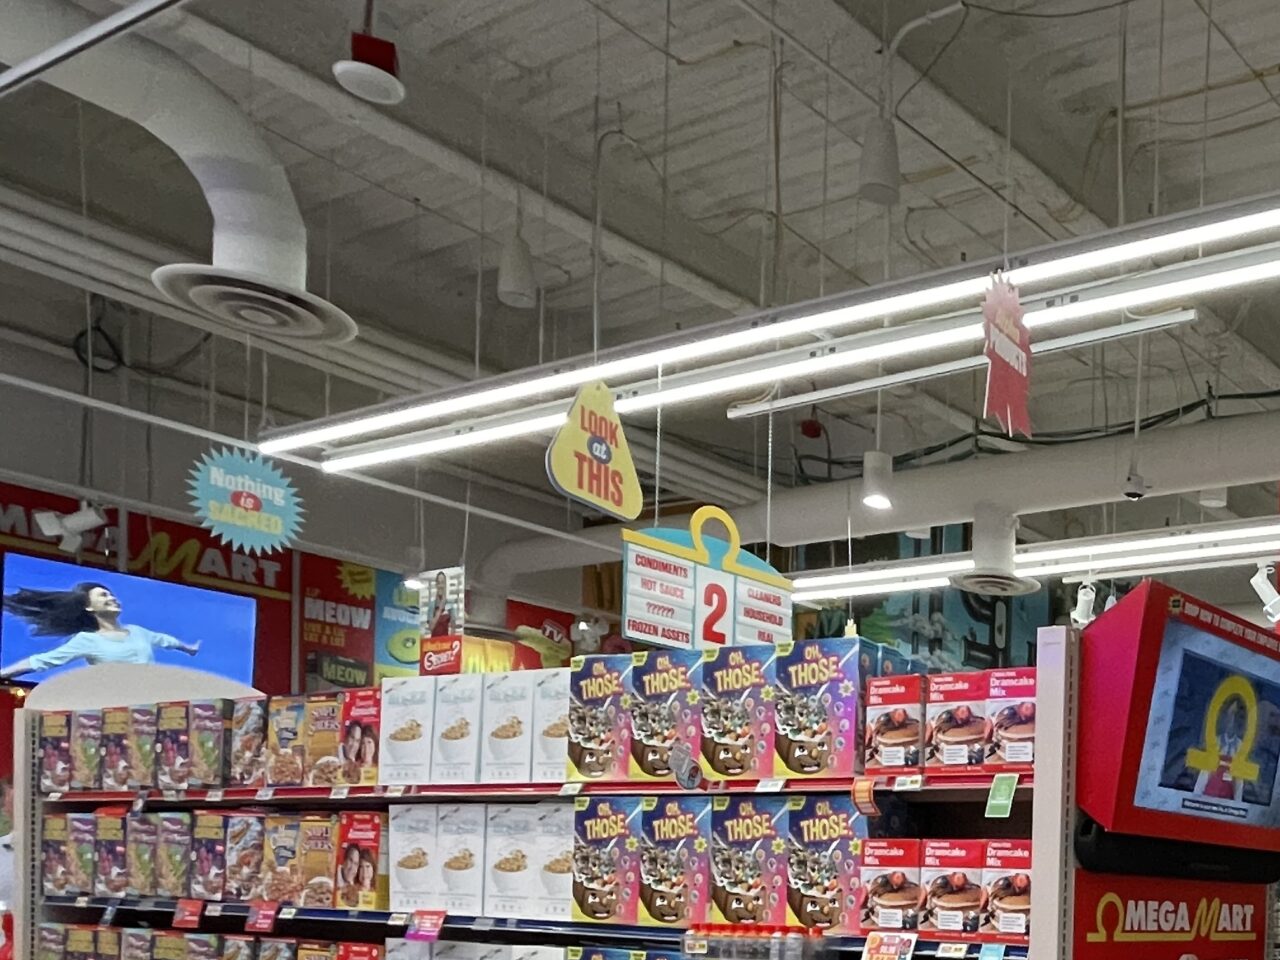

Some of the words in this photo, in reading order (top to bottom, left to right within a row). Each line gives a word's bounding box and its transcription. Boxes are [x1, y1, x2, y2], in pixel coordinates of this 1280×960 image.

[580, 405, 619, 448] LOOK
[593, 441, 607, 459] at
[209, 466, 286, 507] Nothing
[574, 451, 623, 507] THIS
[239, 492, 255, 509] is
[208, 501, 283, 535] SACRED
[137, 532, 282, 588] MART
[635, 554, 688, 579] CONDIMENTS
[640, 578, 657, 593] HOT
[659, 582, 685, 600] SAUCE
[747, 588, 782, 607] CLEANERS
[304, 596, 372, 630] MEOW
[703, 583, 727, 645] 2
[544, 624, 563, 642] TV
[627, 619, 659, 638] FROZEN
[661, 625, 690, 644] ASSETS
[322, 659, 368, 686] MEOW
[869, 683, 905, 694] Dramcake
[930, 680, 969, 692] Dramcake
[989, 676, 1035, 688] Dramcake
[869, 694, 883, 704] Mix
[930, 691, 945, 701] Mix
[989, 687, 1007, 697] Mix
[864, 846, 905, 857] Dramcake
[925, 846, 967, 858] Dramcake
[986, 847, 1030, 858] Dramcake
[864, 856, 880, 866] Mix
[925, 857, 940, 866] Mix
[986, 857, 1002, 867] Mix
[1191, 897, 1256, 942] MART
